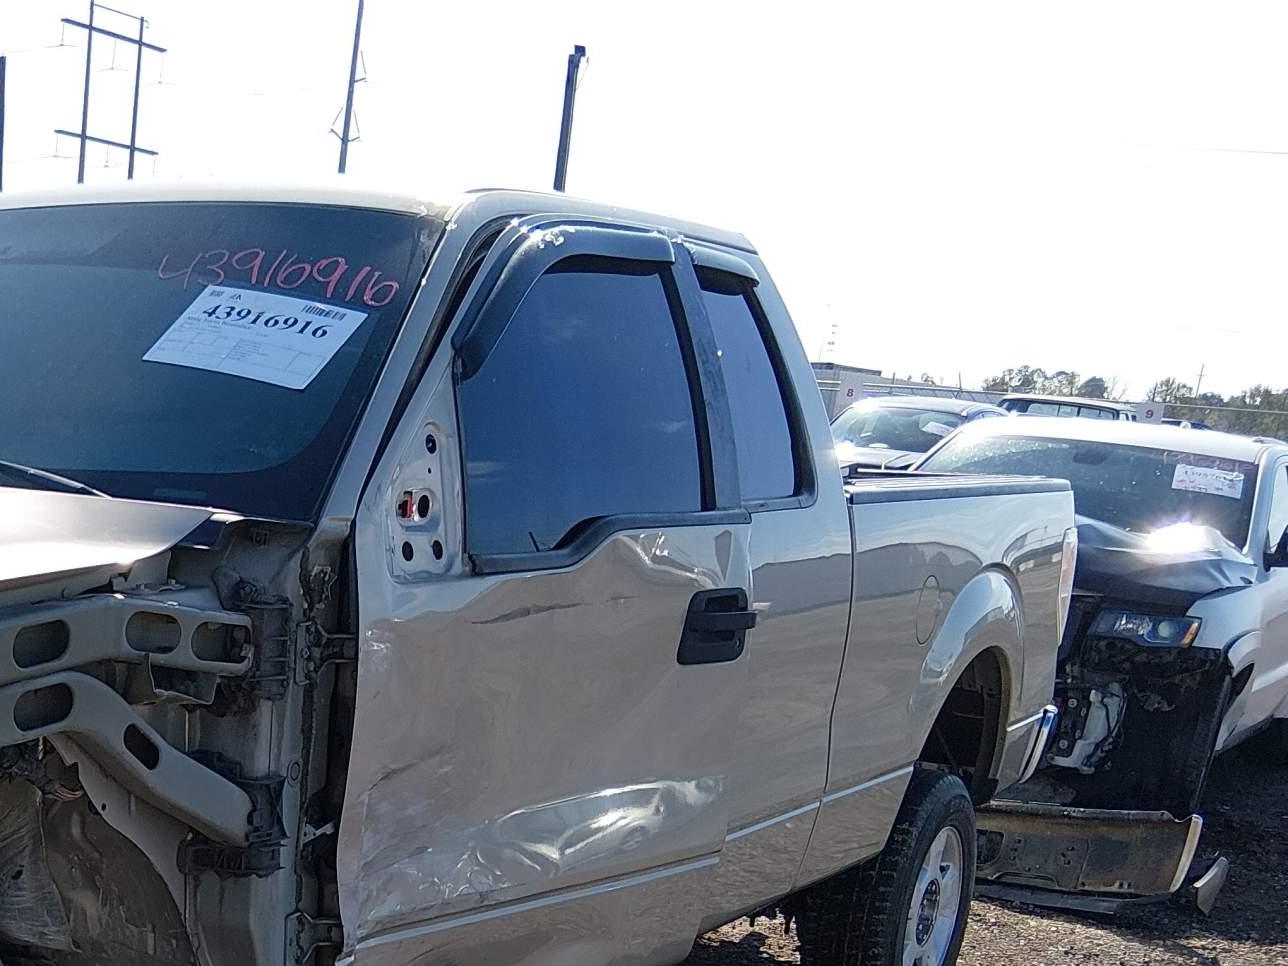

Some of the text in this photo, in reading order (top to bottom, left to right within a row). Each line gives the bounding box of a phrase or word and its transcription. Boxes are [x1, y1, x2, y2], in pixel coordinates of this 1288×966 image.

[158, 248, 400, 307] 43916916
[202, 304, 334, 339] 43916916
[846, 388, 854, 397] 8
[1145, 409, 1154, 419] 9
